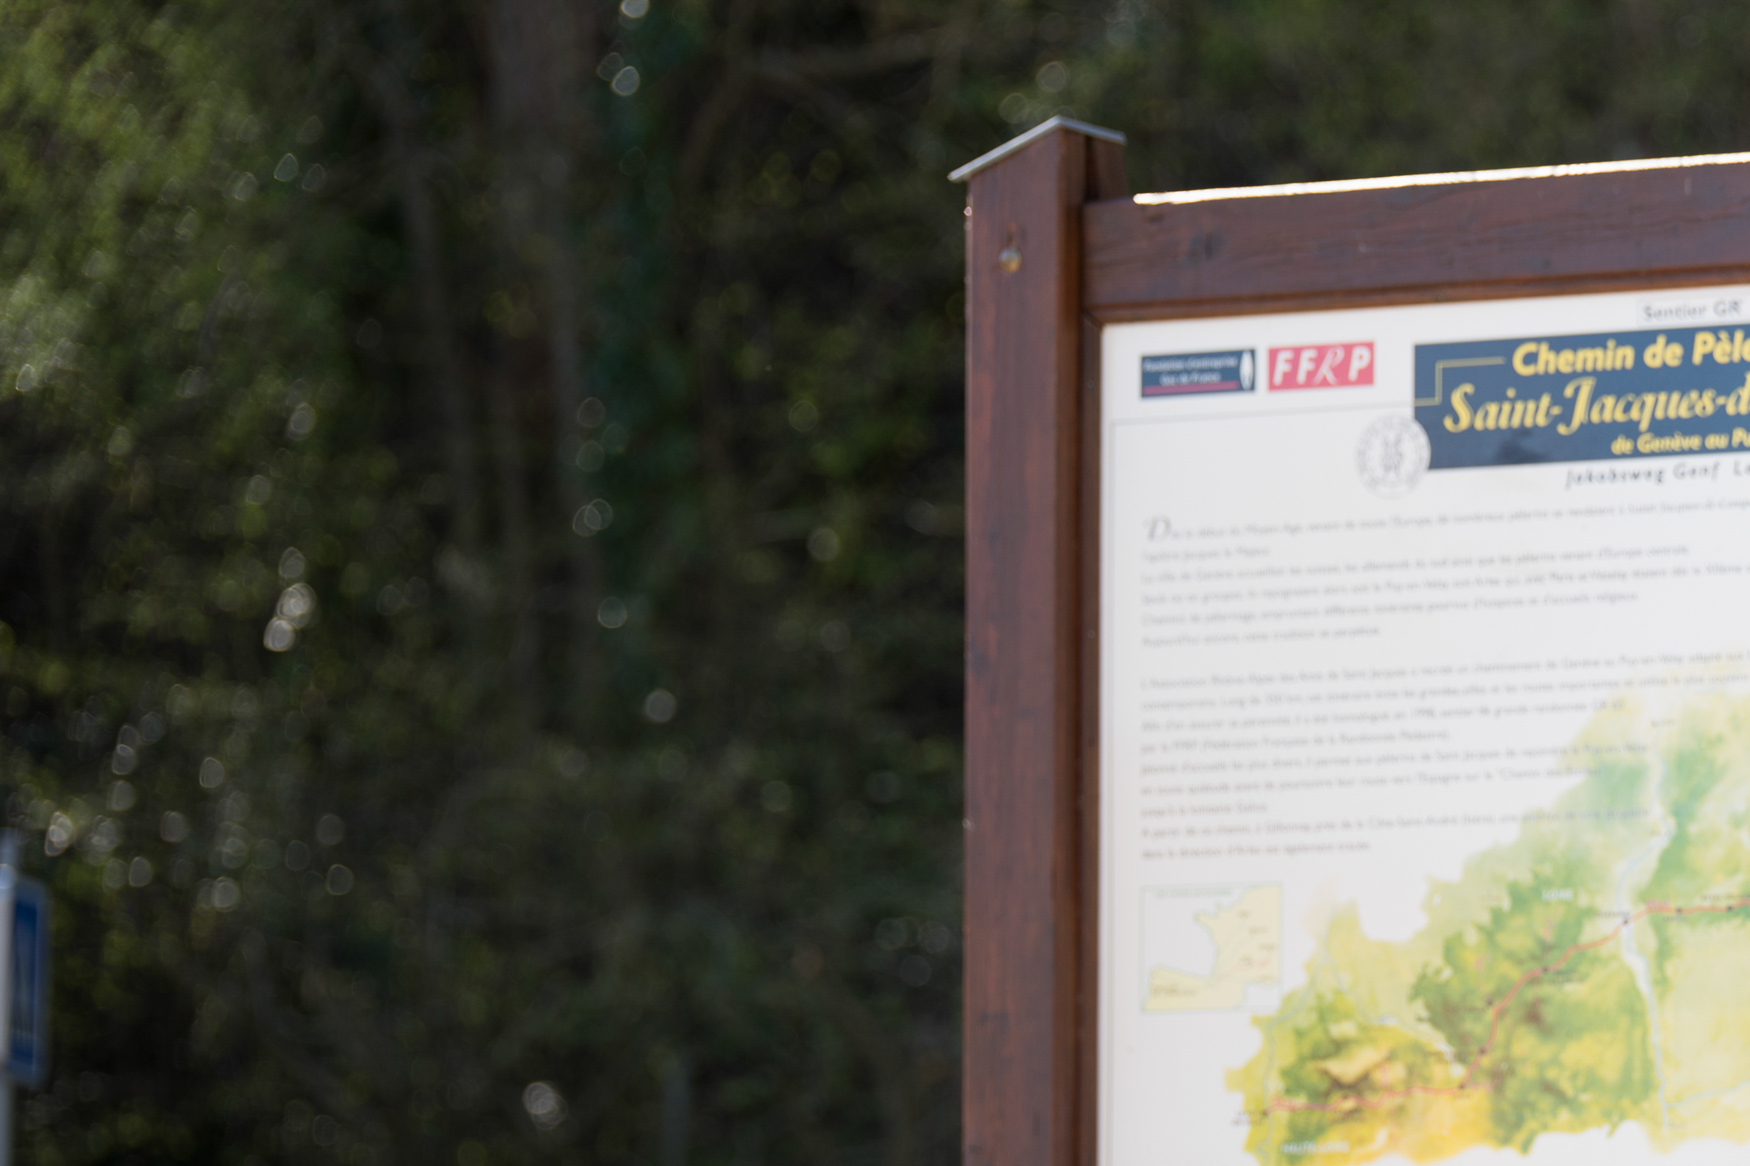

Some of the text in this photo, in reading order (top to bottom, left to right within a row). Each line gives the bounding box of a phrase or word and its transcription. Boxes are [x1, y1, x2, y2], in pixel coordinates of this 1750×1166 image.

[1272, 345, 1373, 387] FFRP
[1512, 339, 1635, 376] Chemin
[1643, 334, 1683, 368] de
[1612, 433, 1634, 456] de
[1637, 429, 1701, 454] Genève
[1705, 432, 1728, 450] au
[1566, 462, 1666, 489] Jakobsweg
[1674, 461, 1720, 481] Genf
